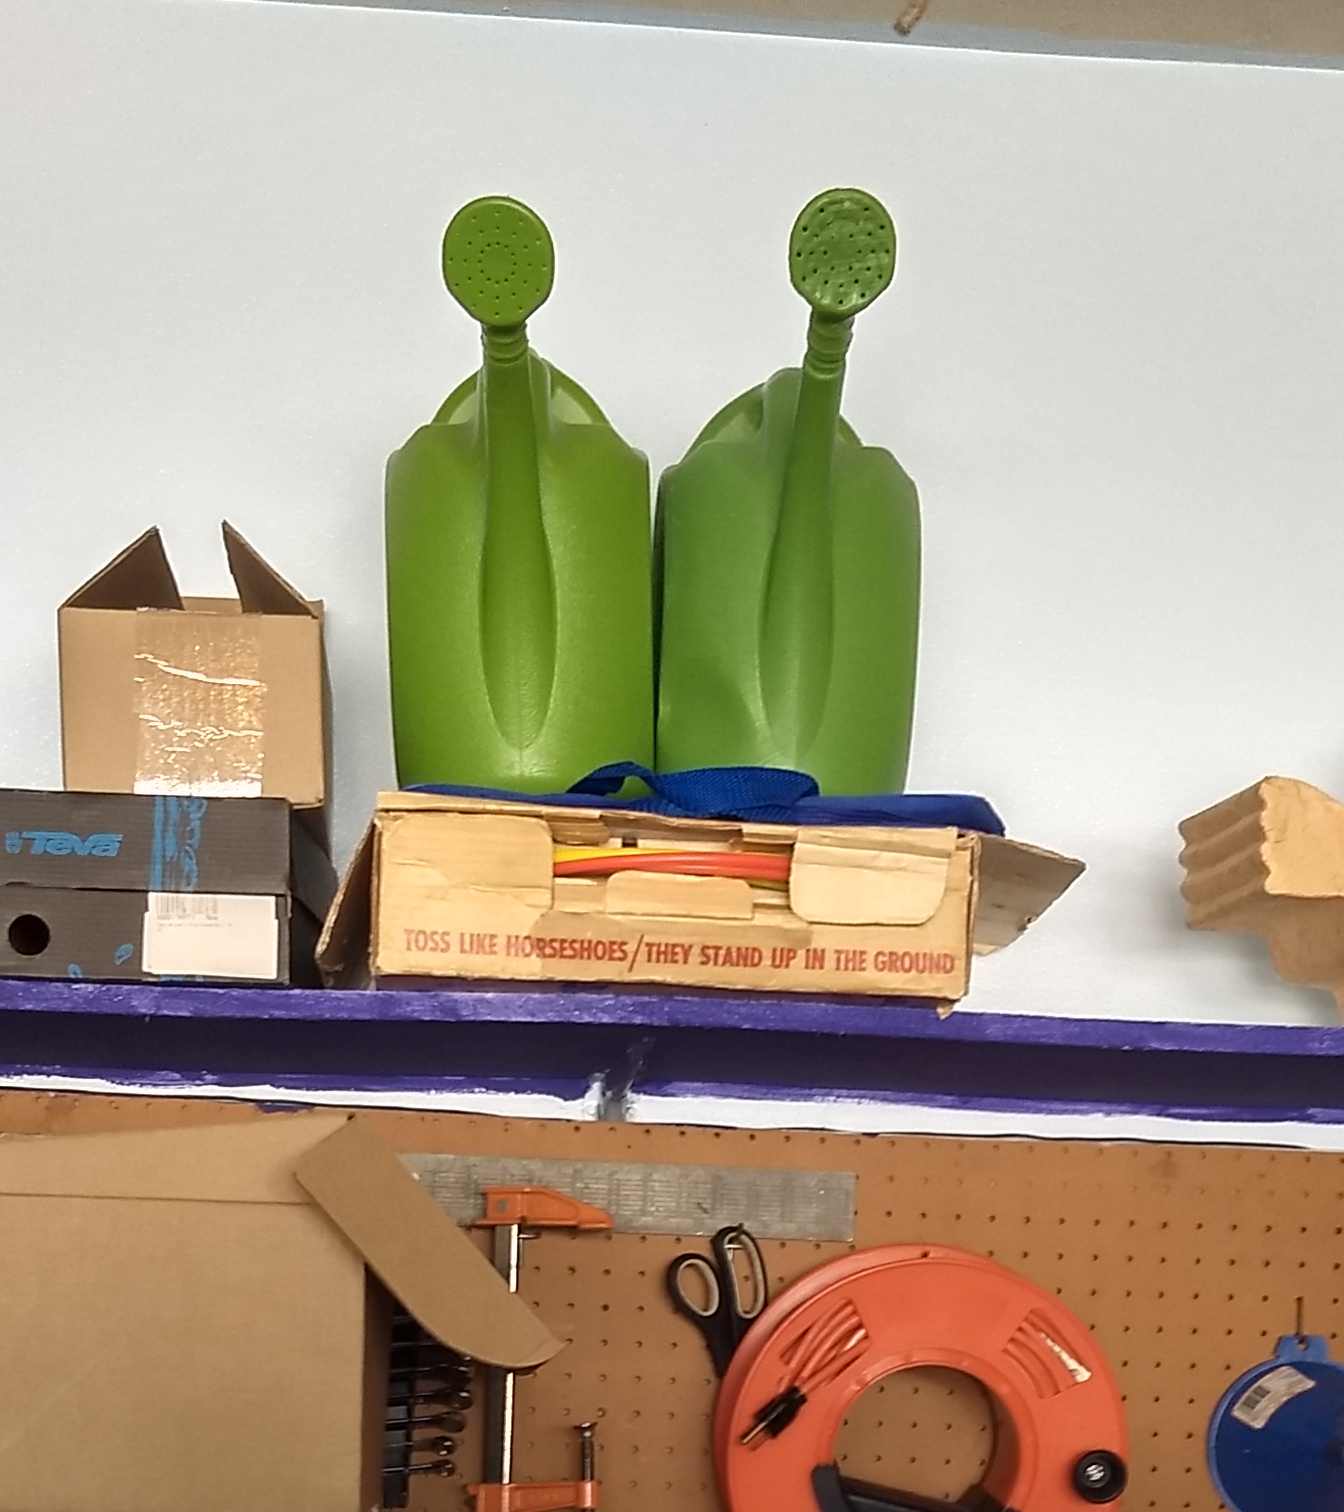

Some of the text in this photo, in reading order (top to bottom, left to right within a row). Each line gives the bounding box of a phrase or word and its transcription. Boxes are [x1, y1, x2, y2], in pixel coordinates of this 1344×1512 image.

[21, 831, 123, 857] Teva
[403, 928, 452, 954] TOSS
[458, 932, 499, 956] LIKE
[699, 943, 763, 968] STAND
[770, 947, 797, 970] UP
[804, 948, 826, 971] IN
[833, 949, 868, 973] THE
[873, 950, 956, 975] GROUND
